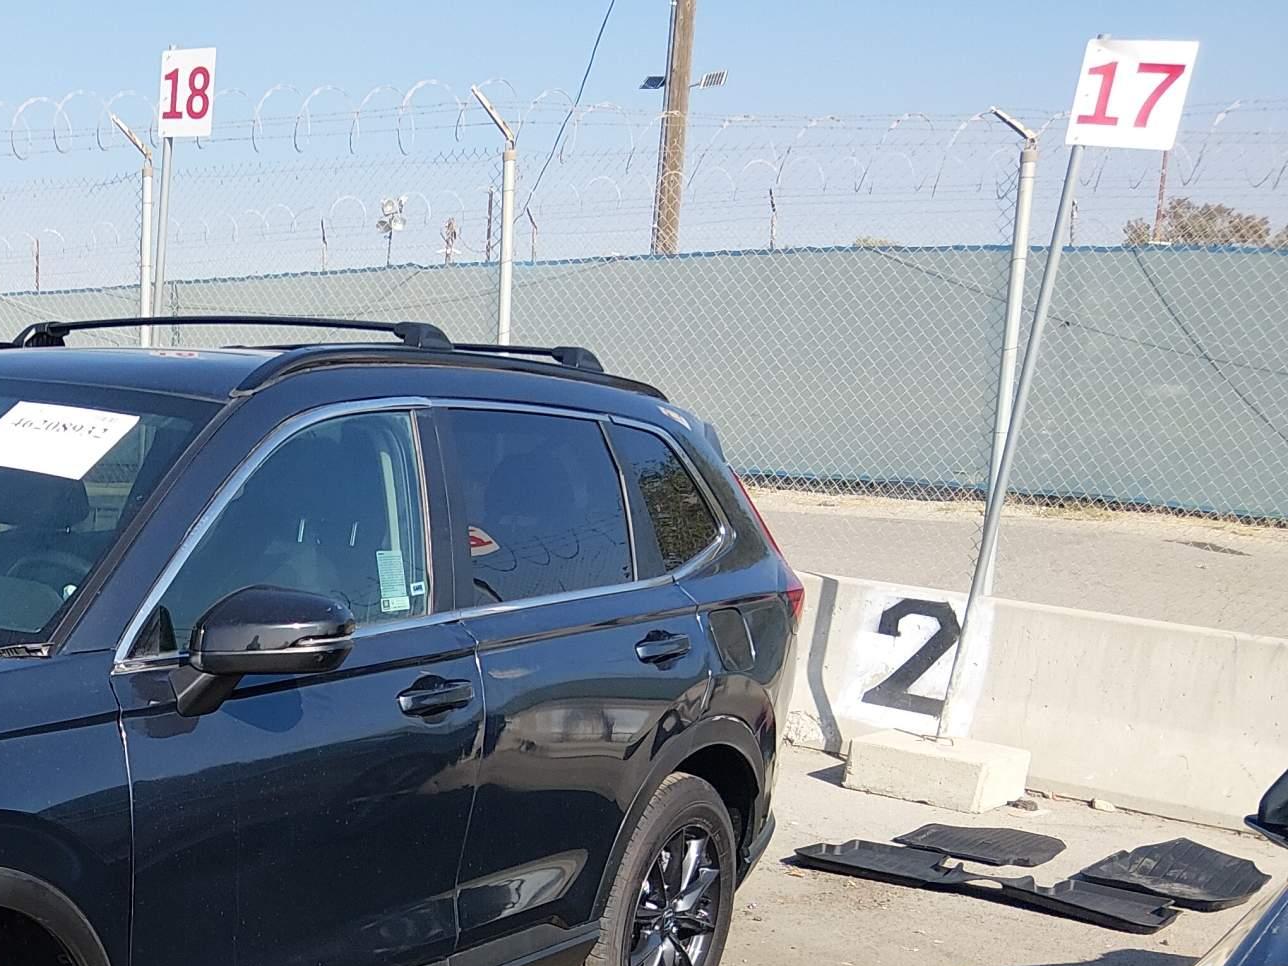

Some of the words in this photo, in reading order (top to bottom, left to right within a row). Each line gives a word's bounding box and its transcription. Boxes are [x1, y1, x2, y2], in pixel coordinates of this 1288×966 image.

[161, 66, 211, 120] 18
[1075, 61, 1187, 129] 17
[861, 597, 962, 719] 2
